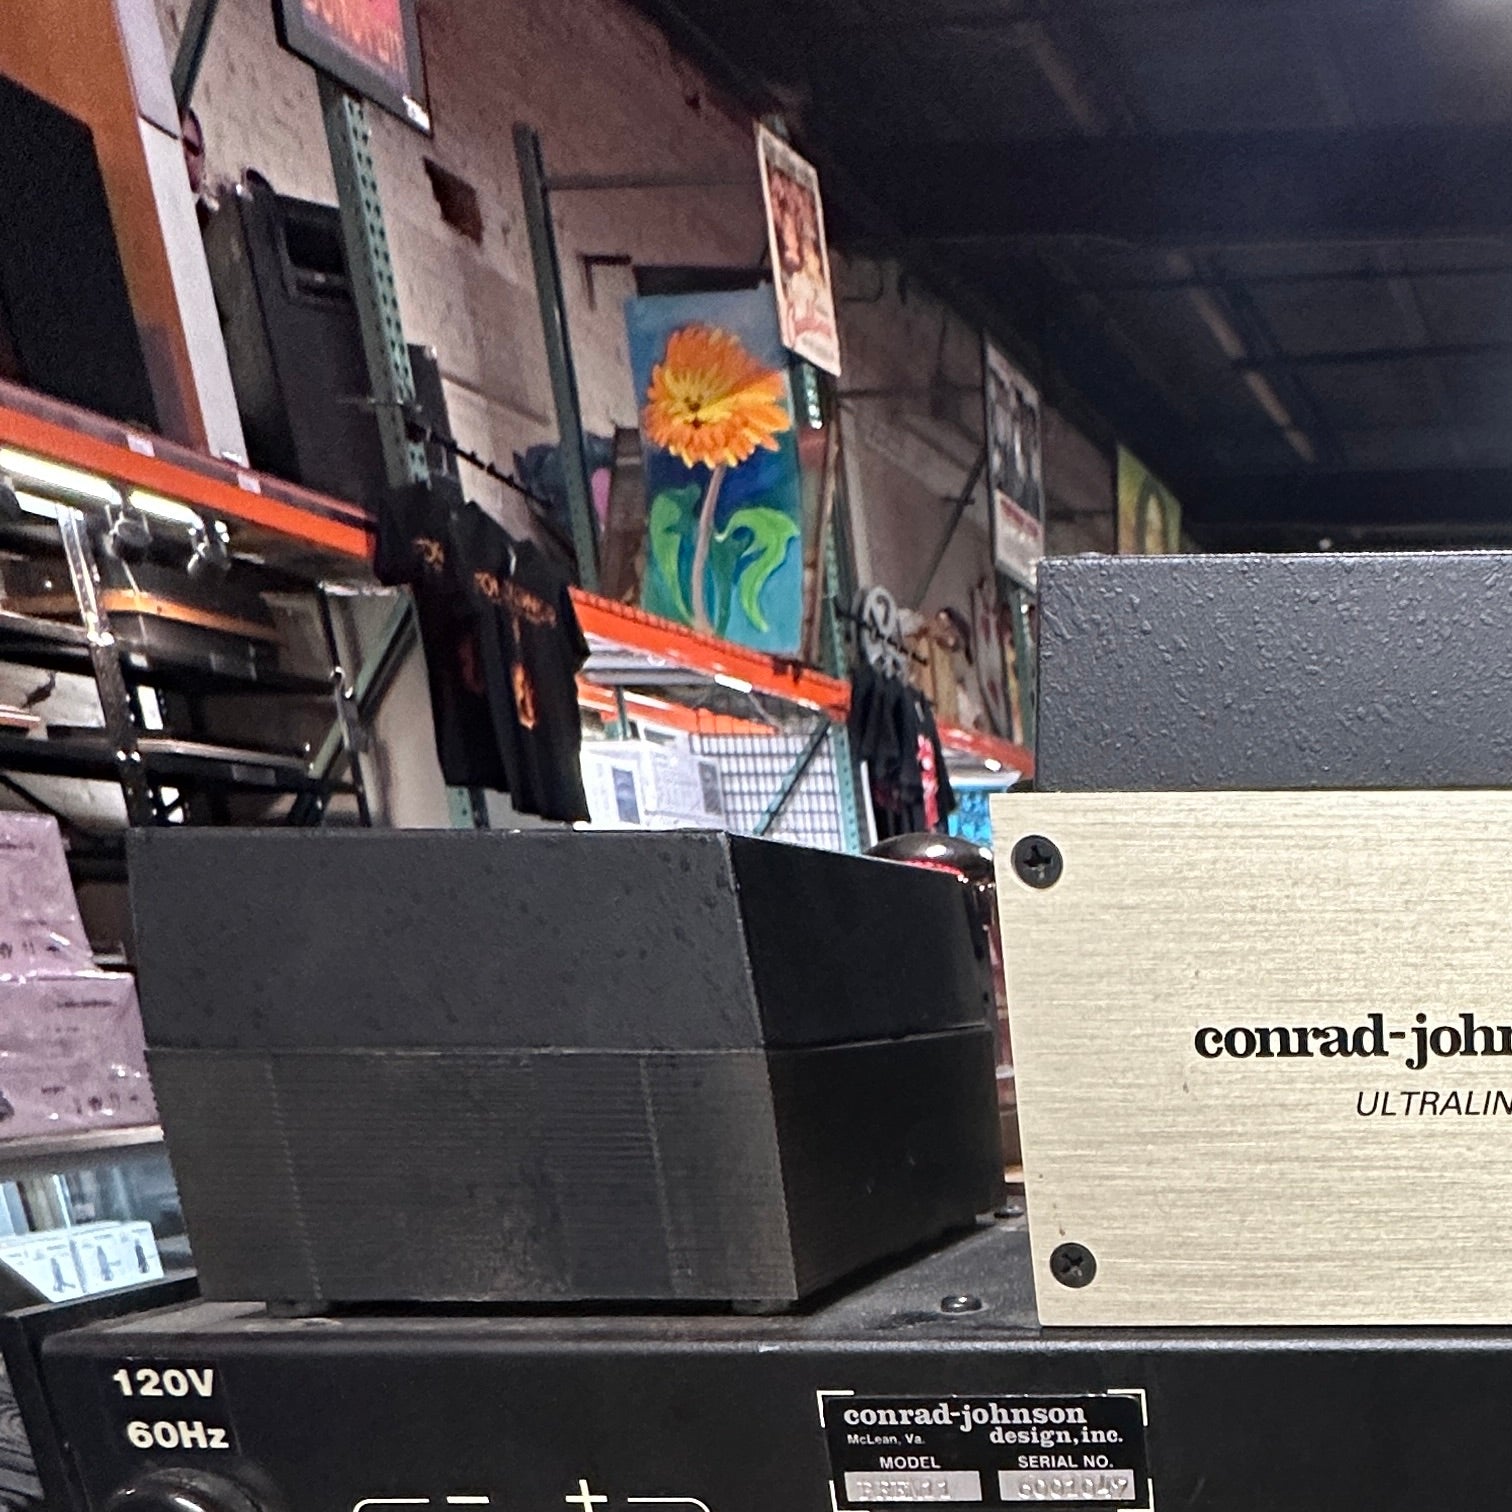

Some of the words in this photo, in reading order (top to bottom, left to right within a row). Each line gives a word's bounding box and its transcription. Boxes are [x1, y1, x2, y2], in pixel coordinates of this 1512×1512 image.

[112, 1368, 214, 1397] 120V
[844, 1402, 1088, 1432] conrad-johnson
[127, 1420, 230, 1449] 60Hz
[847, 1433, 901, 1447] McLean,
[904, 1433, 926, 1445] Va.
[879, 1456, 941, 1470] MODEL
[1017, 1455, 1079, 1469] SERIAL
[1083, 1454, 1114, 1468] NO.
